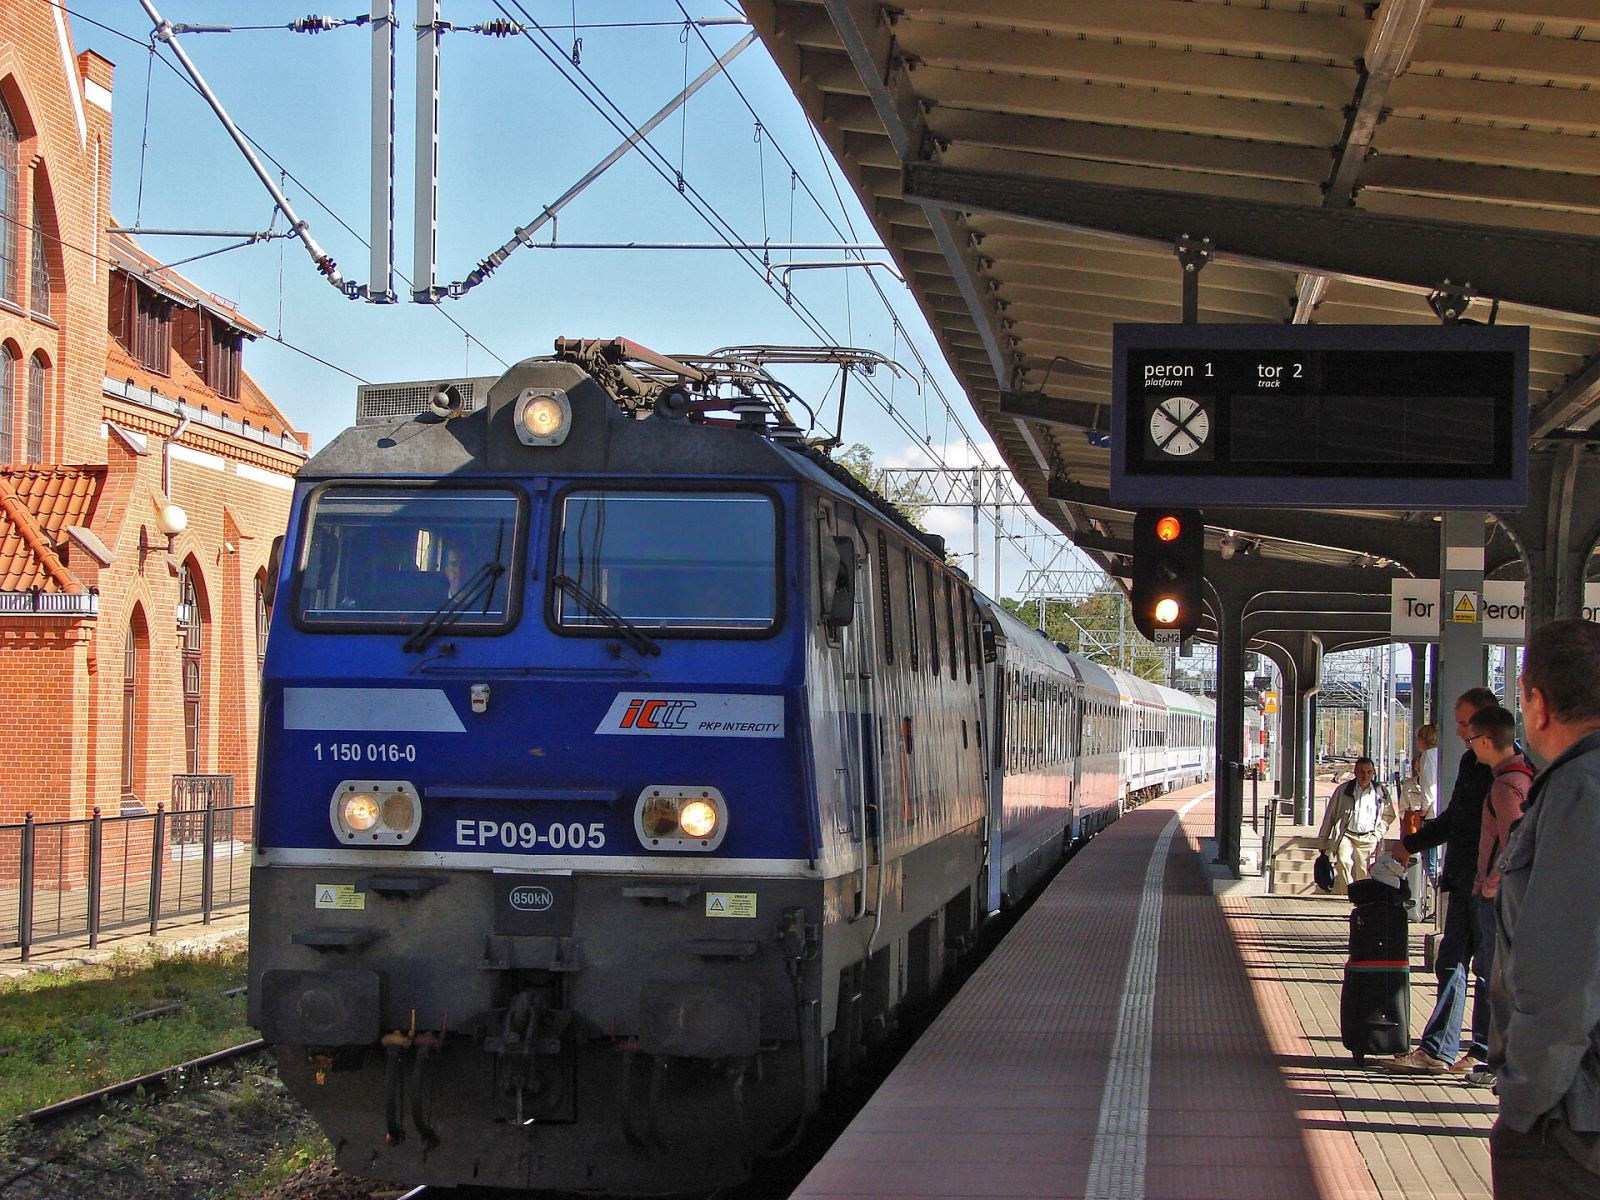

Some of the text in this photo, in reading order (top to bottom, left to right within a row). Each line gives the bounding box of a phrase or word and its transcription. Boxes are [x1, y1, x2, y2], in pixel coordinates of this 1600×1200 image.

[1144, 362, 1215, 379] peron 1
[1257, 363, 1303, 378] tor 2
[1144, 378, 1183, 388] platform
[1257, 379, 1281, 388] track
[1403, 597, 1435, 617] Tor
[1156, 633, 1180, 643] SpM2
[698, 722, 780, 732] PKP INTERCITY
[314, 743, 416, 762] 1 150 016-0
[456, 819, 606, 849] EP09-005
[513, 892, 550, 905] 850kN
